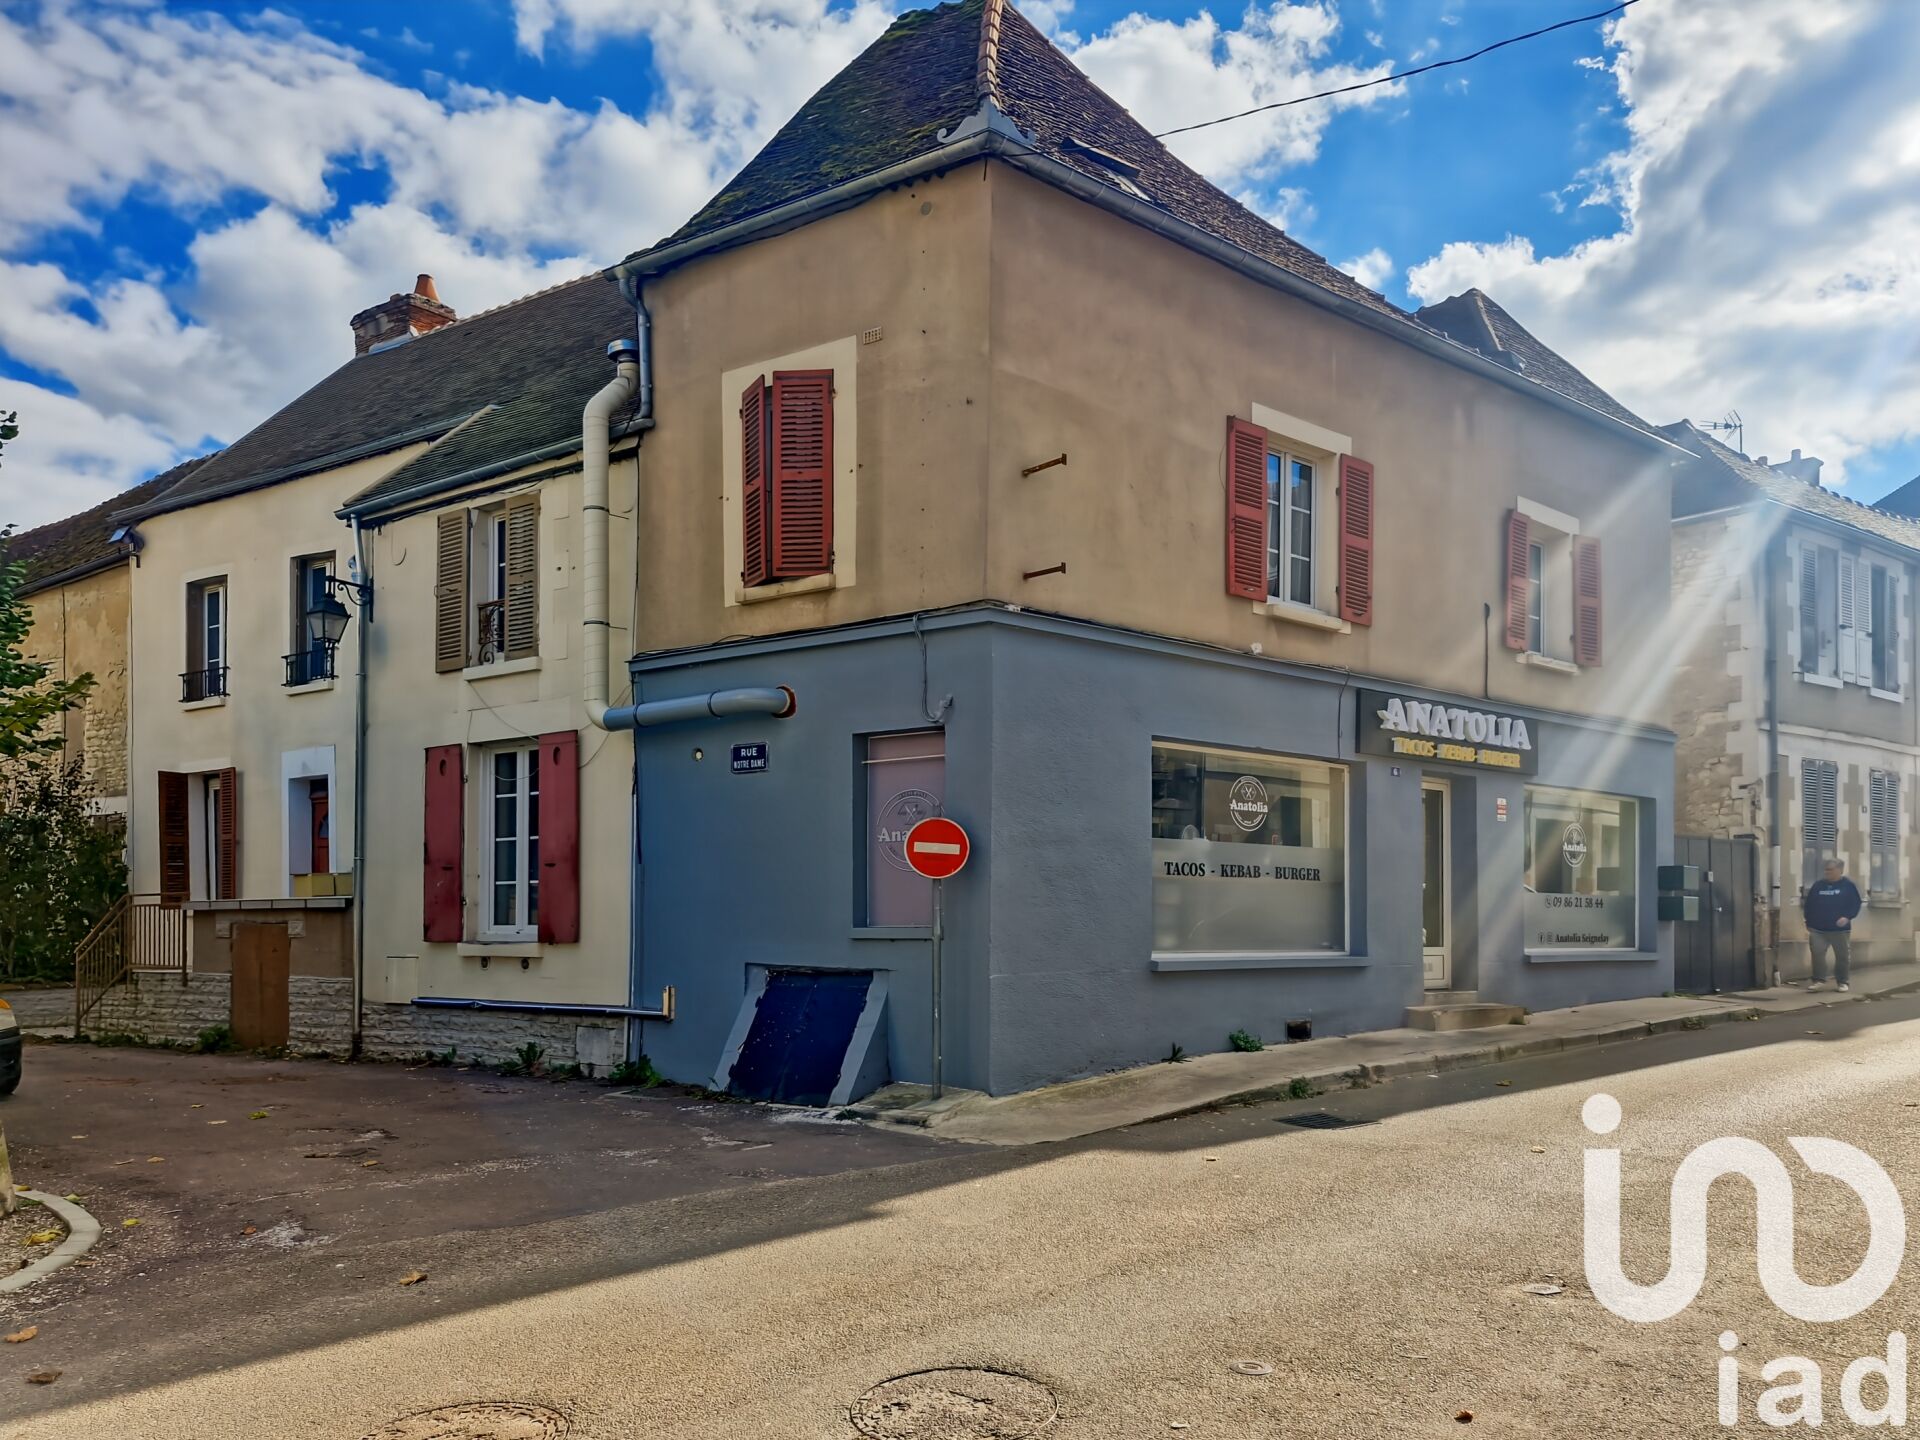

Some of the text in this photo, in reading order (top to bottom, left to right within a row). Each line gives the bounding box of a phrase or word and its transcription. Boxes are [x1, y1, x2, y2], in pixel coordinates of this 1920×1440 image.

[1377, 698, 1531, 749] ANATOLIA
[741, 747, 757, 757] RUE
[734, 758, 765, 769] NOTRE DAME
[1229, 798, 1268, 813] Anatolia
[1164, 862, 1206, 877] TACOS
[1220, 864, 1261, 878] KEBAB
[1275, 867, 1321, 881] BURGER
[1553, 897, 1562, 908] 09
[1574, 897, 1582, 908] 21
[1595, 898, 1603, 909] 44
[1555, 933, 1580, 943] Anatolia
